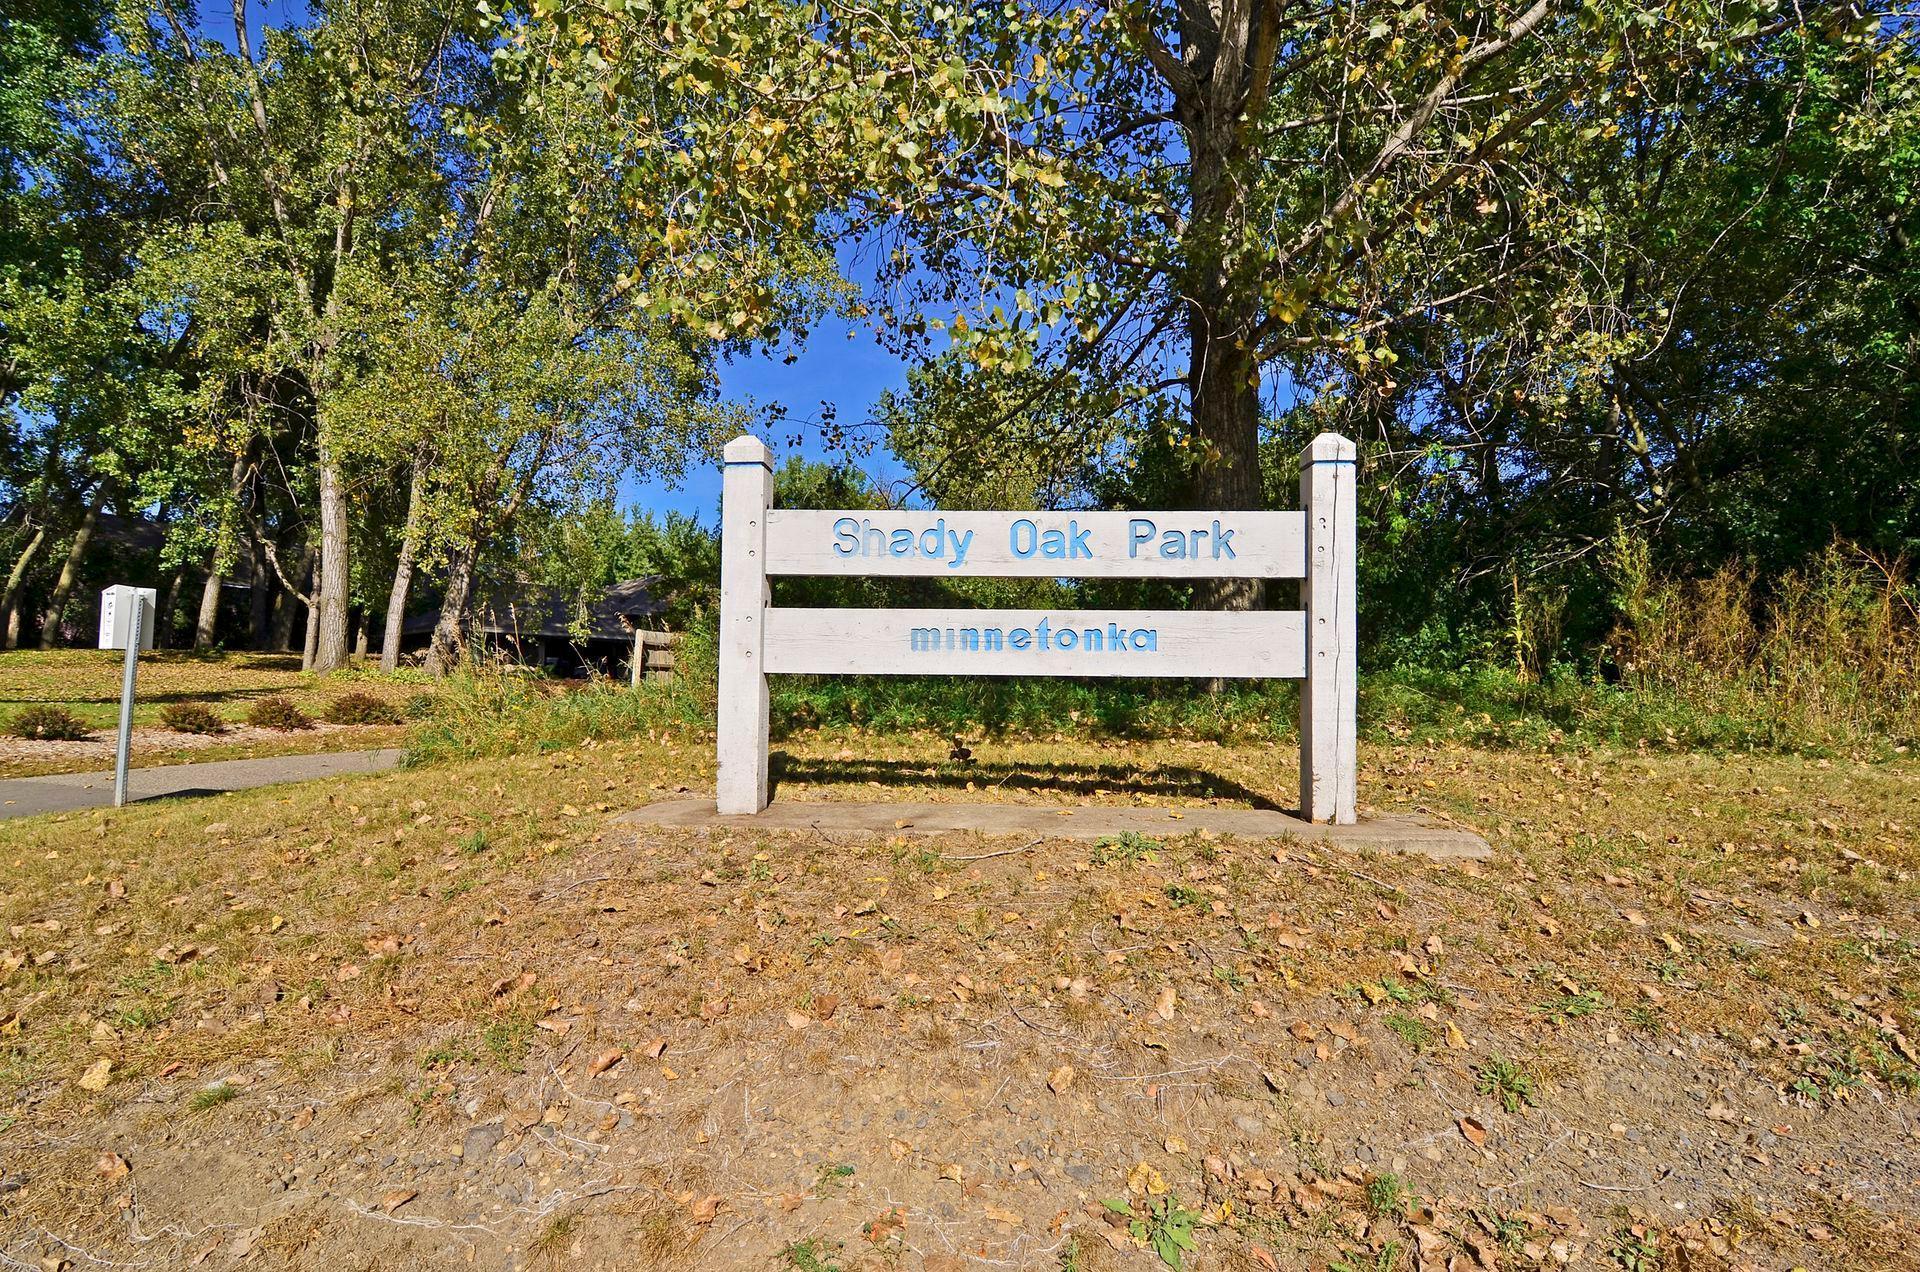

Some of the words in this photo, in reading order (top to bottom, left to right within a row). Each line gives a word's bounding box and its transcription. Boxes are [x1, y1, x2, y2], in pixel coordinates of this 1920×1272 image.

[832, 517, 974, 568] Shady
[1009, 518, 1094, 560] Oak
[1128, 519, 1237, 560] Park
[910, 616, 1158, 652] minnetonka
